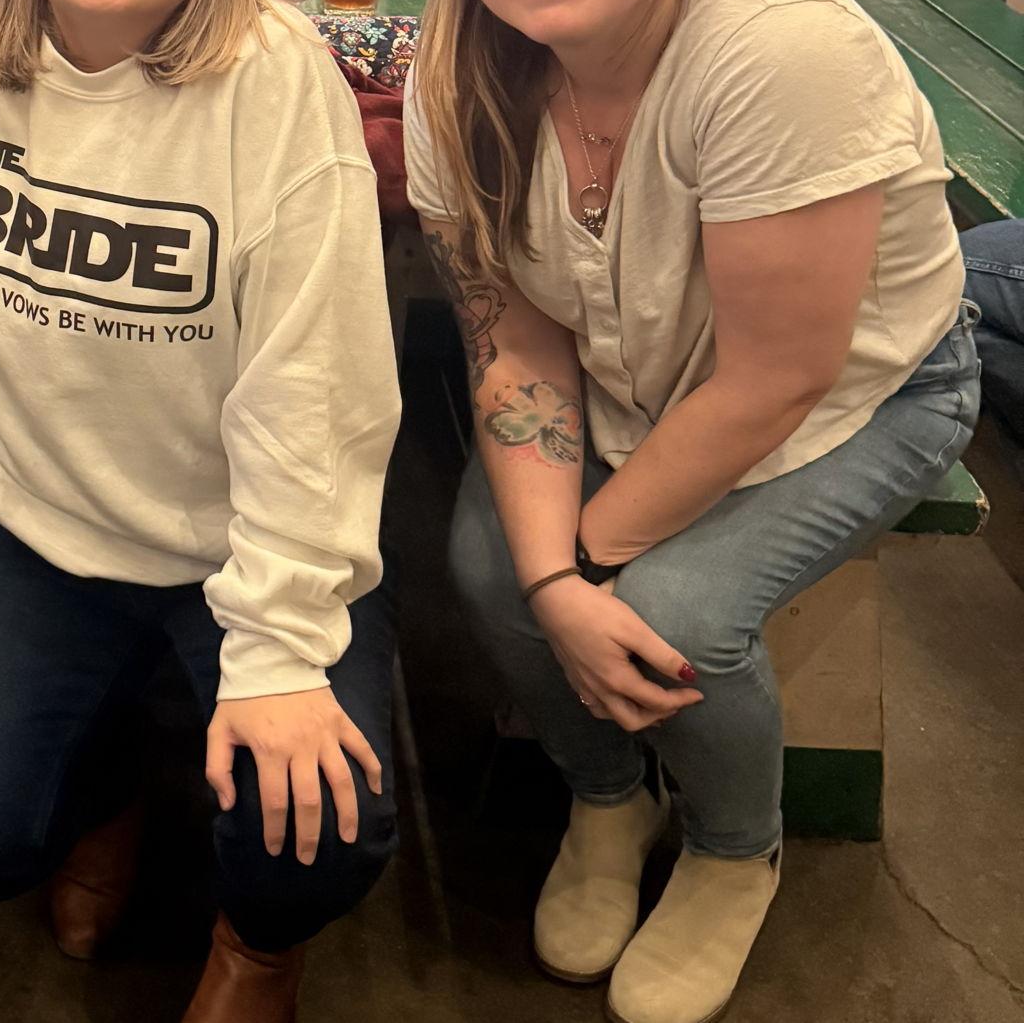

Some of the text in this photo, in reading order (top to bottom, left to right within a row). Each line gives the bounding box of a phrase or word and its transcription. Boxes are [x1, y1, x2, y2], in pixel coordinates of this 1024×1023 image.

[2, 287, 49, 326] VOWS
[58, 310, 86, 332] BE
[94, 317, 155, 342] WITH
[163, 324, 214, 343] YOU
